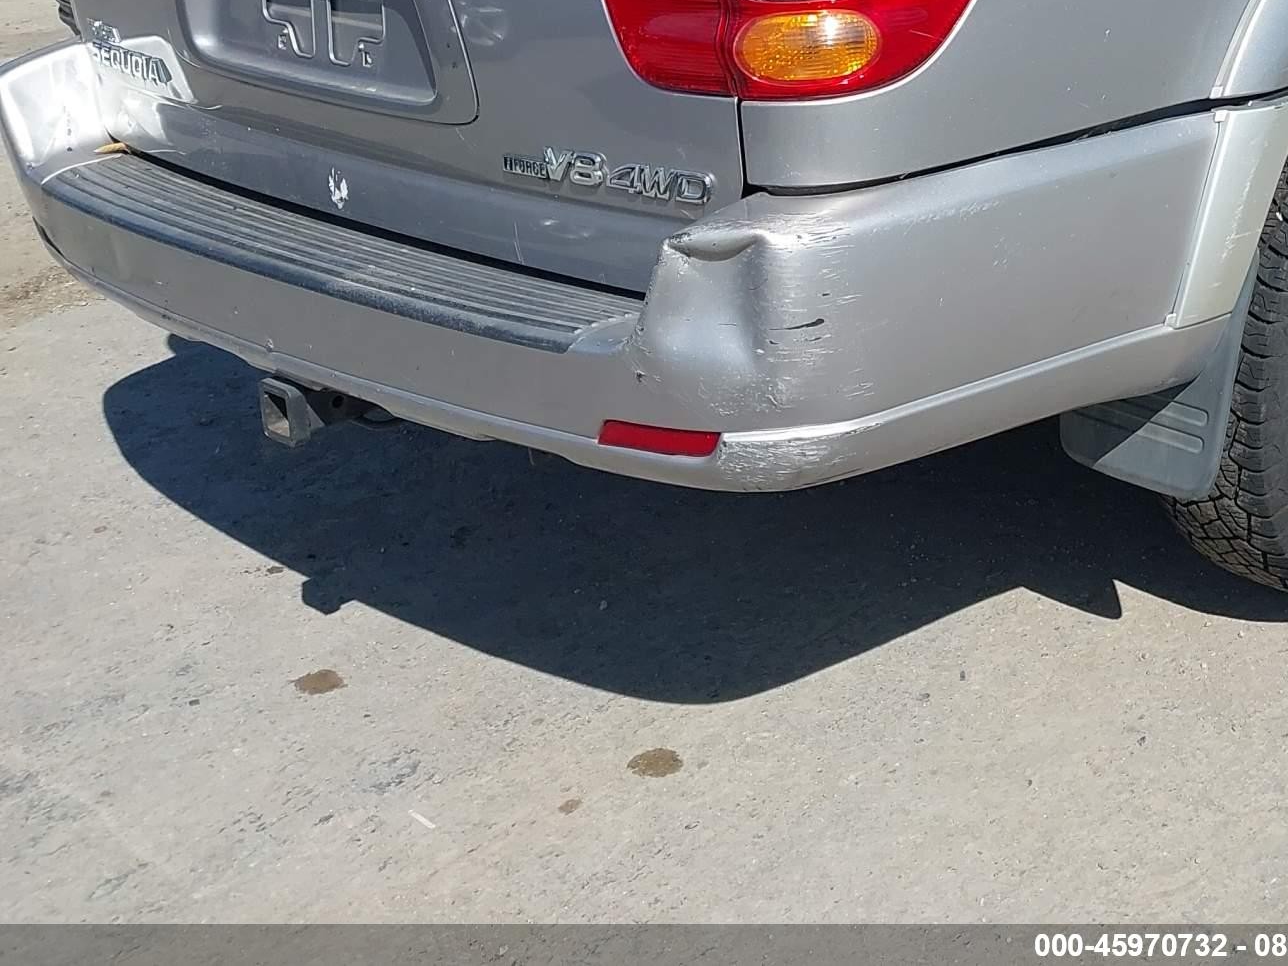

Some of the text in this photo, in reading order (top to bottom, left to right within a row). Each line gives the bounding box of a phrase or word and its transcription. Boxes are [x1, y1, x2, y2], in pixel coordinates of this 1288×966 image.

[91, 43, 168, 86] SEQUOIA
[544, 146, 606, 186] V8
[607, 163, 714, 205] 4WD
